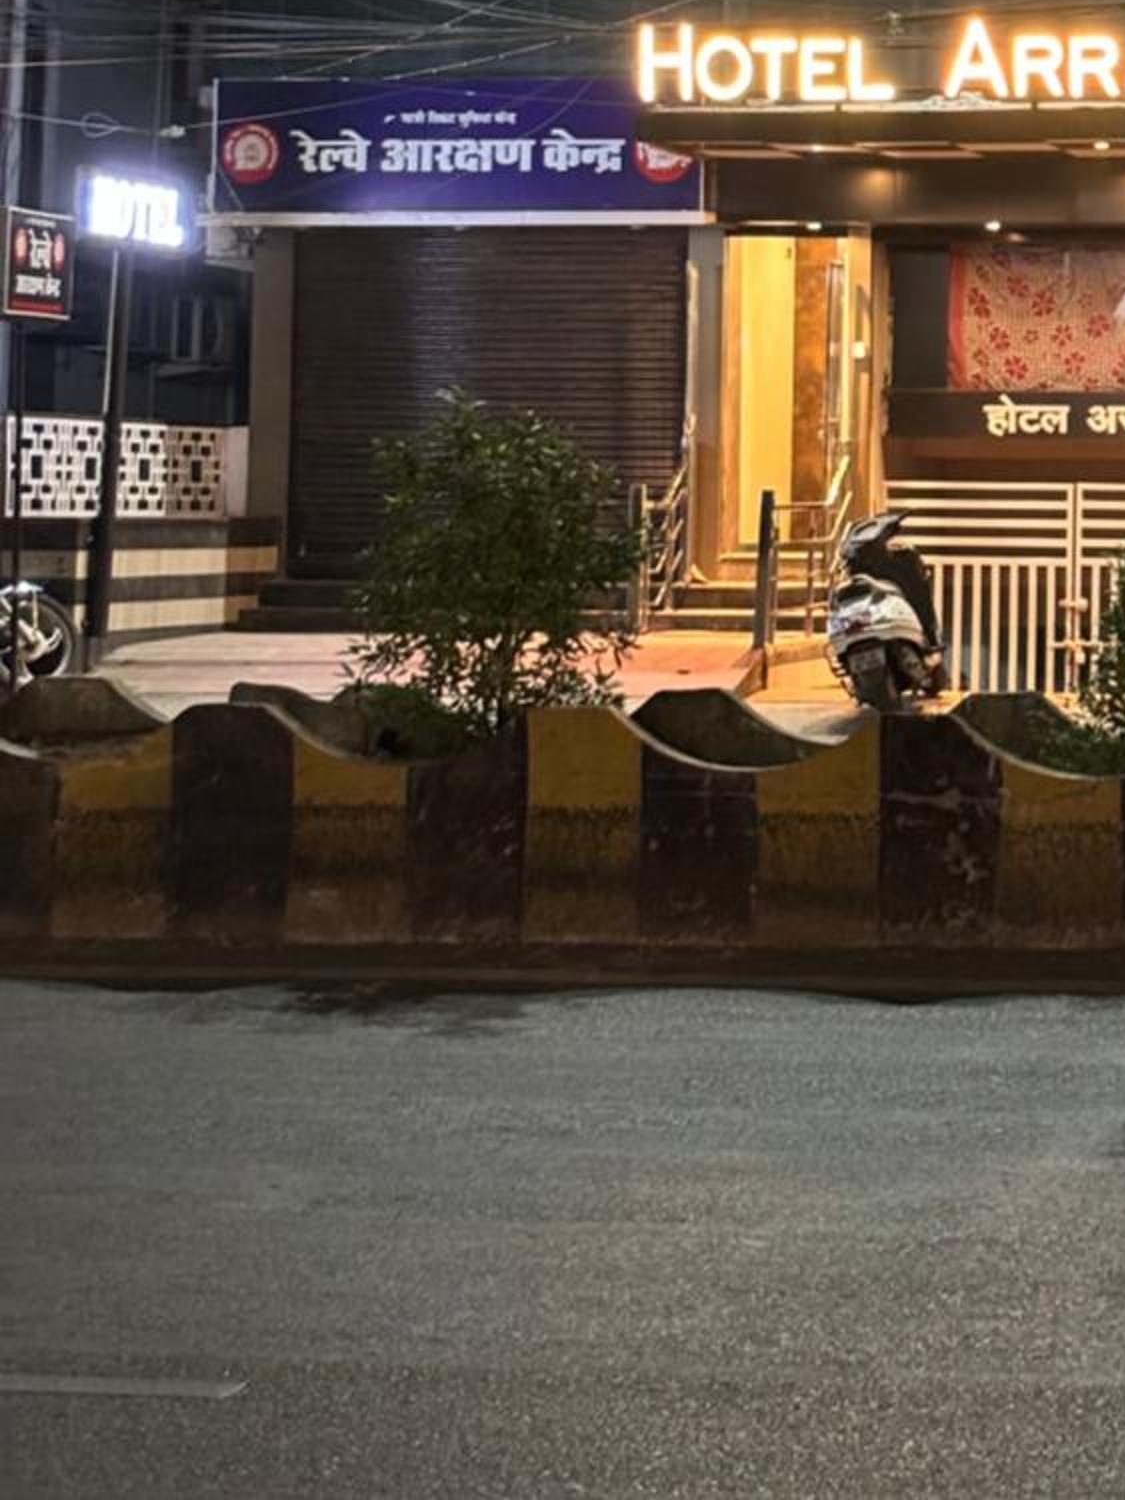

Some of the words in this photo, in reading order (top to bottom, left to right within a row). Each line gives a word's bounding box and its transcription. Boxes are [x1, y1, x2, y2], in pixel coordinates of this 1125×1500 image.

[637, 20, 895, 102] HOTEL
[289, 129, 371, 173] रेल्वे
[381, 137, 536, 173] आरक्षण
[982, 393, 1070, 436] होटल
